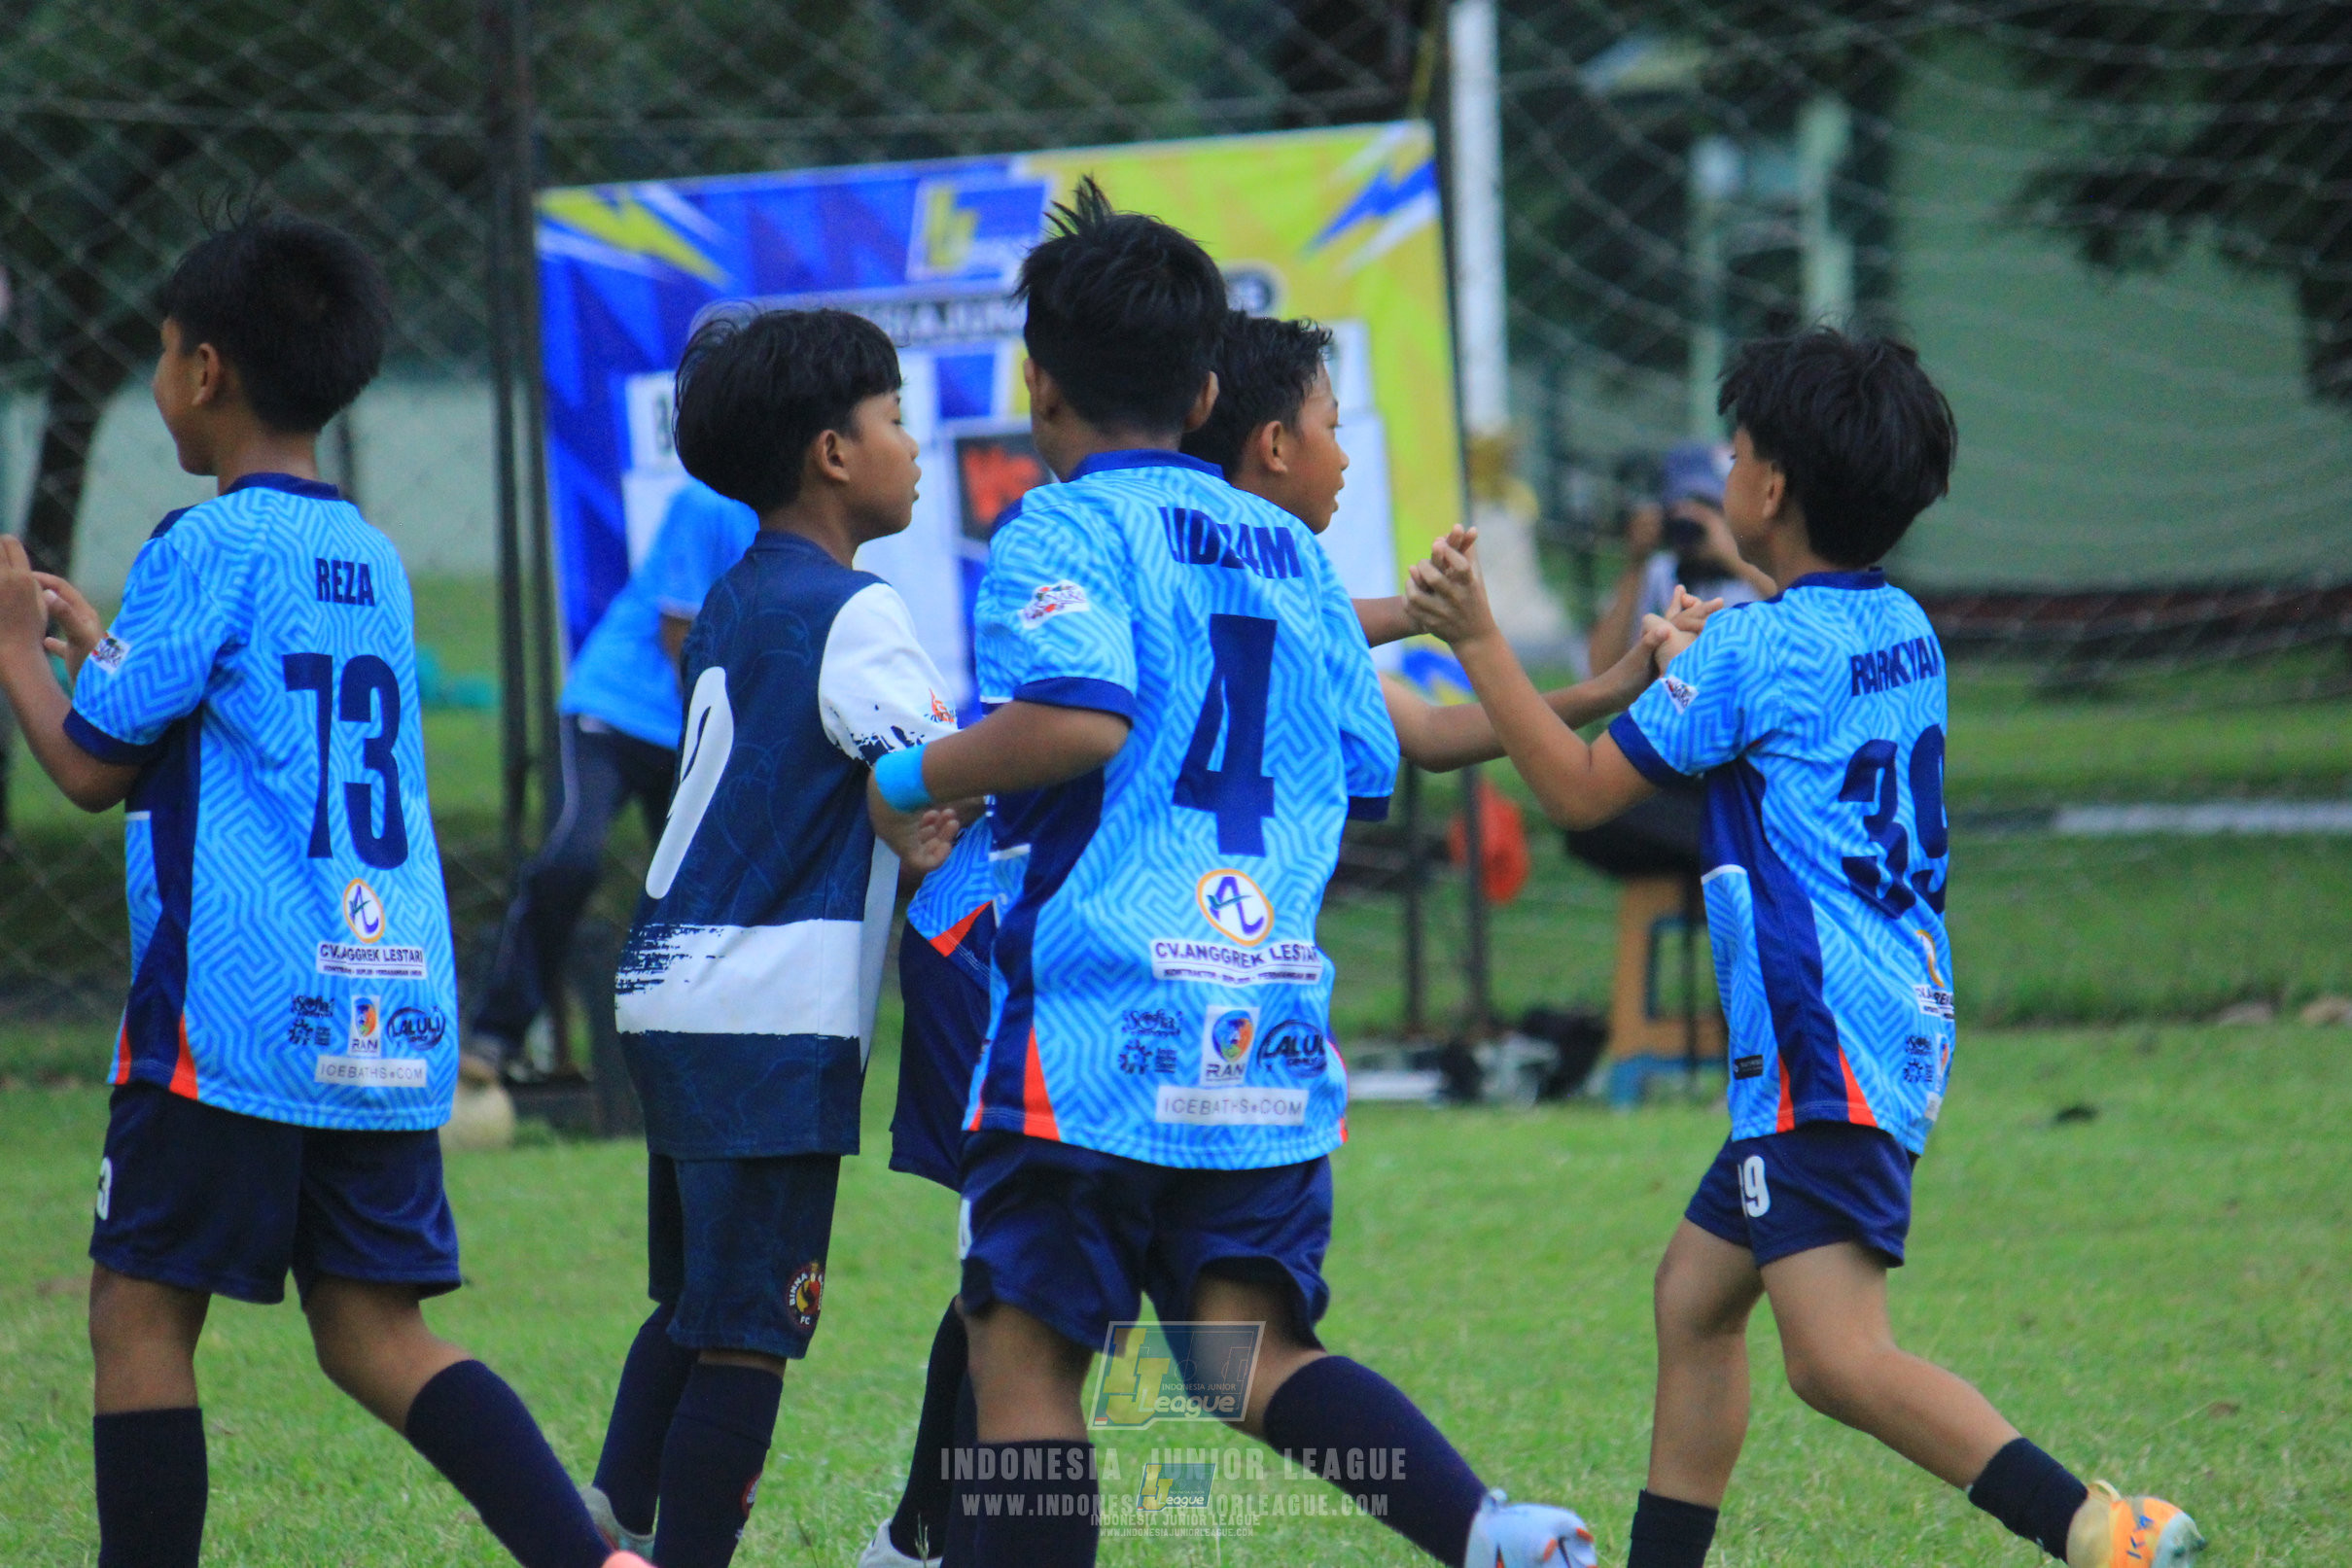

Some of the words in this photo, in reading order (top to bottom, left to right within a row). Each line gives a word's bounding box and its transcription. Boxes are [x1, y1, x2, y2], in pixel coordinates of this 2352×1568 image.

[315, 557, 375, 607] REZA
[1172, 613, 1278, 857] 4
[282, 652, 408, 870] 73
[383, 949, 424, 963] LESTARI
[1155, 942, 1265, 968] CV.ANGGREK
[351, 1038, 377, 1051] RAN
[1206, 1063, 1245, 1078] RAN
